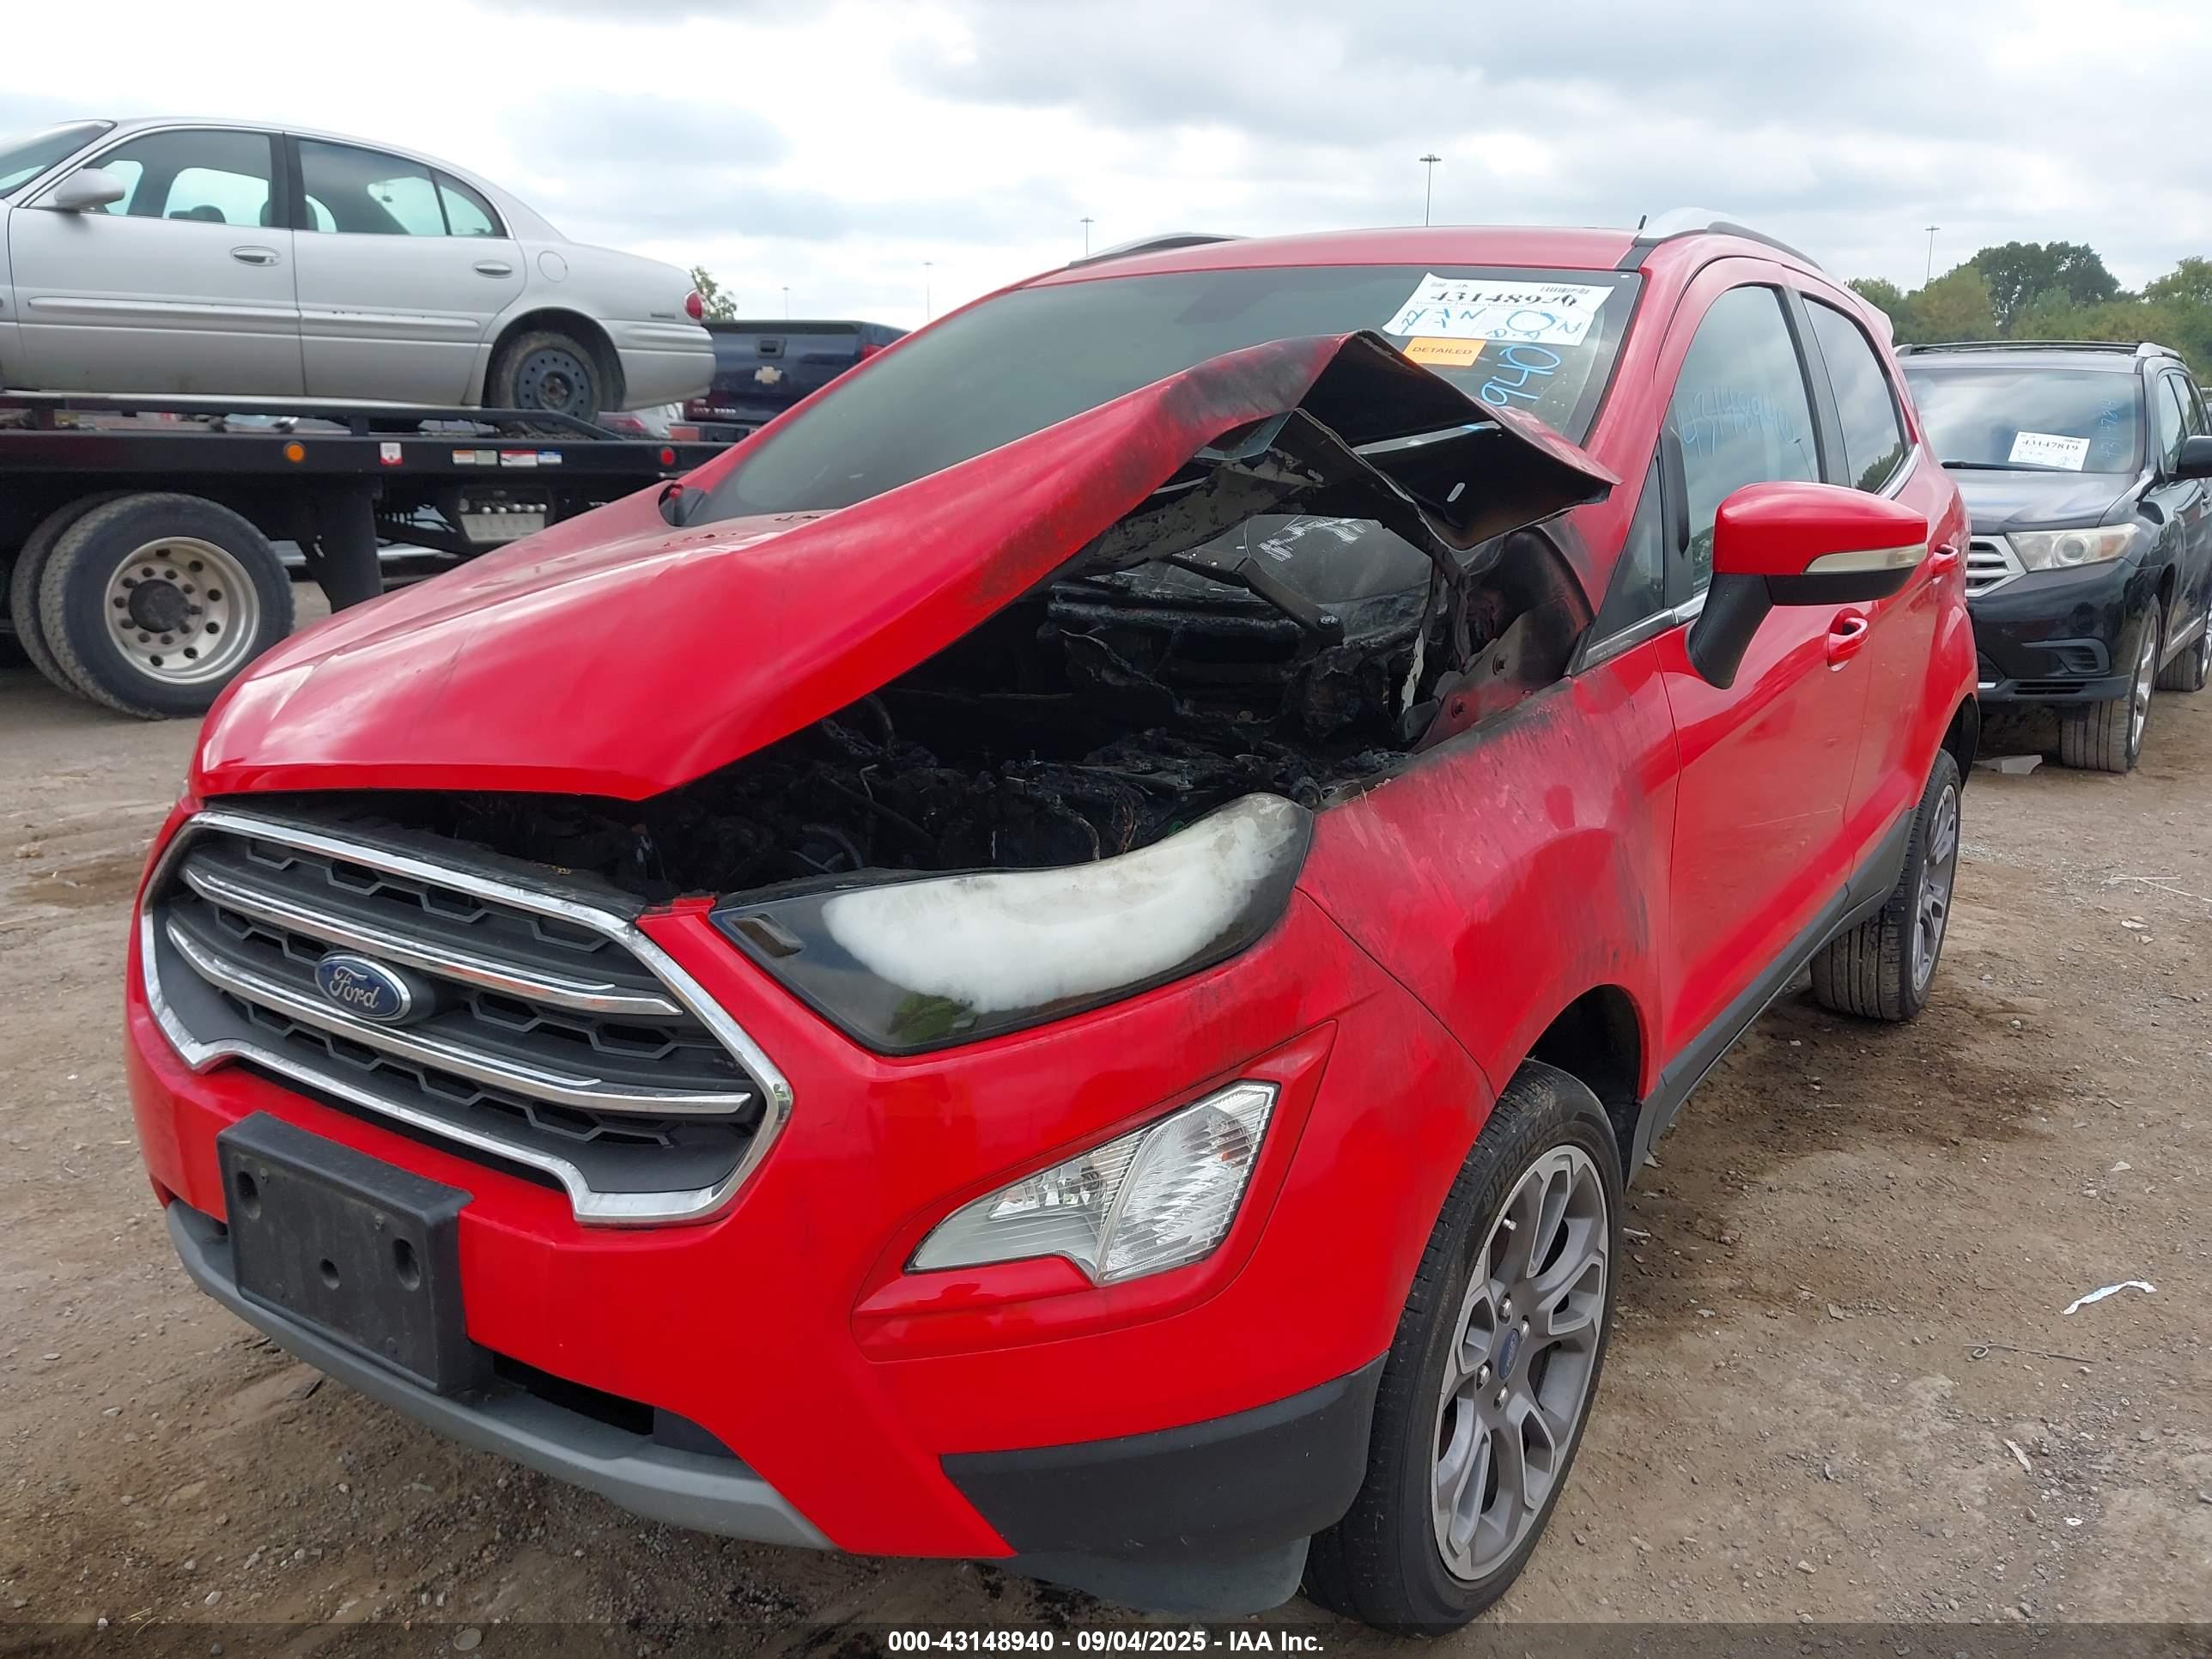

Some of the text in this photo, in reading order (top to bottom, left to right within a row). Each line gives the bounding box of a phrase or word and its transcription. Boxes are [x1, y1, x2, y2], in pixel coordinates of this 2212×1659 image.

[1412, 346, 1473, 355] DETAILED
[1481, 345, 1561, 405] 940
[329, 966, 380, 1009] Ford
